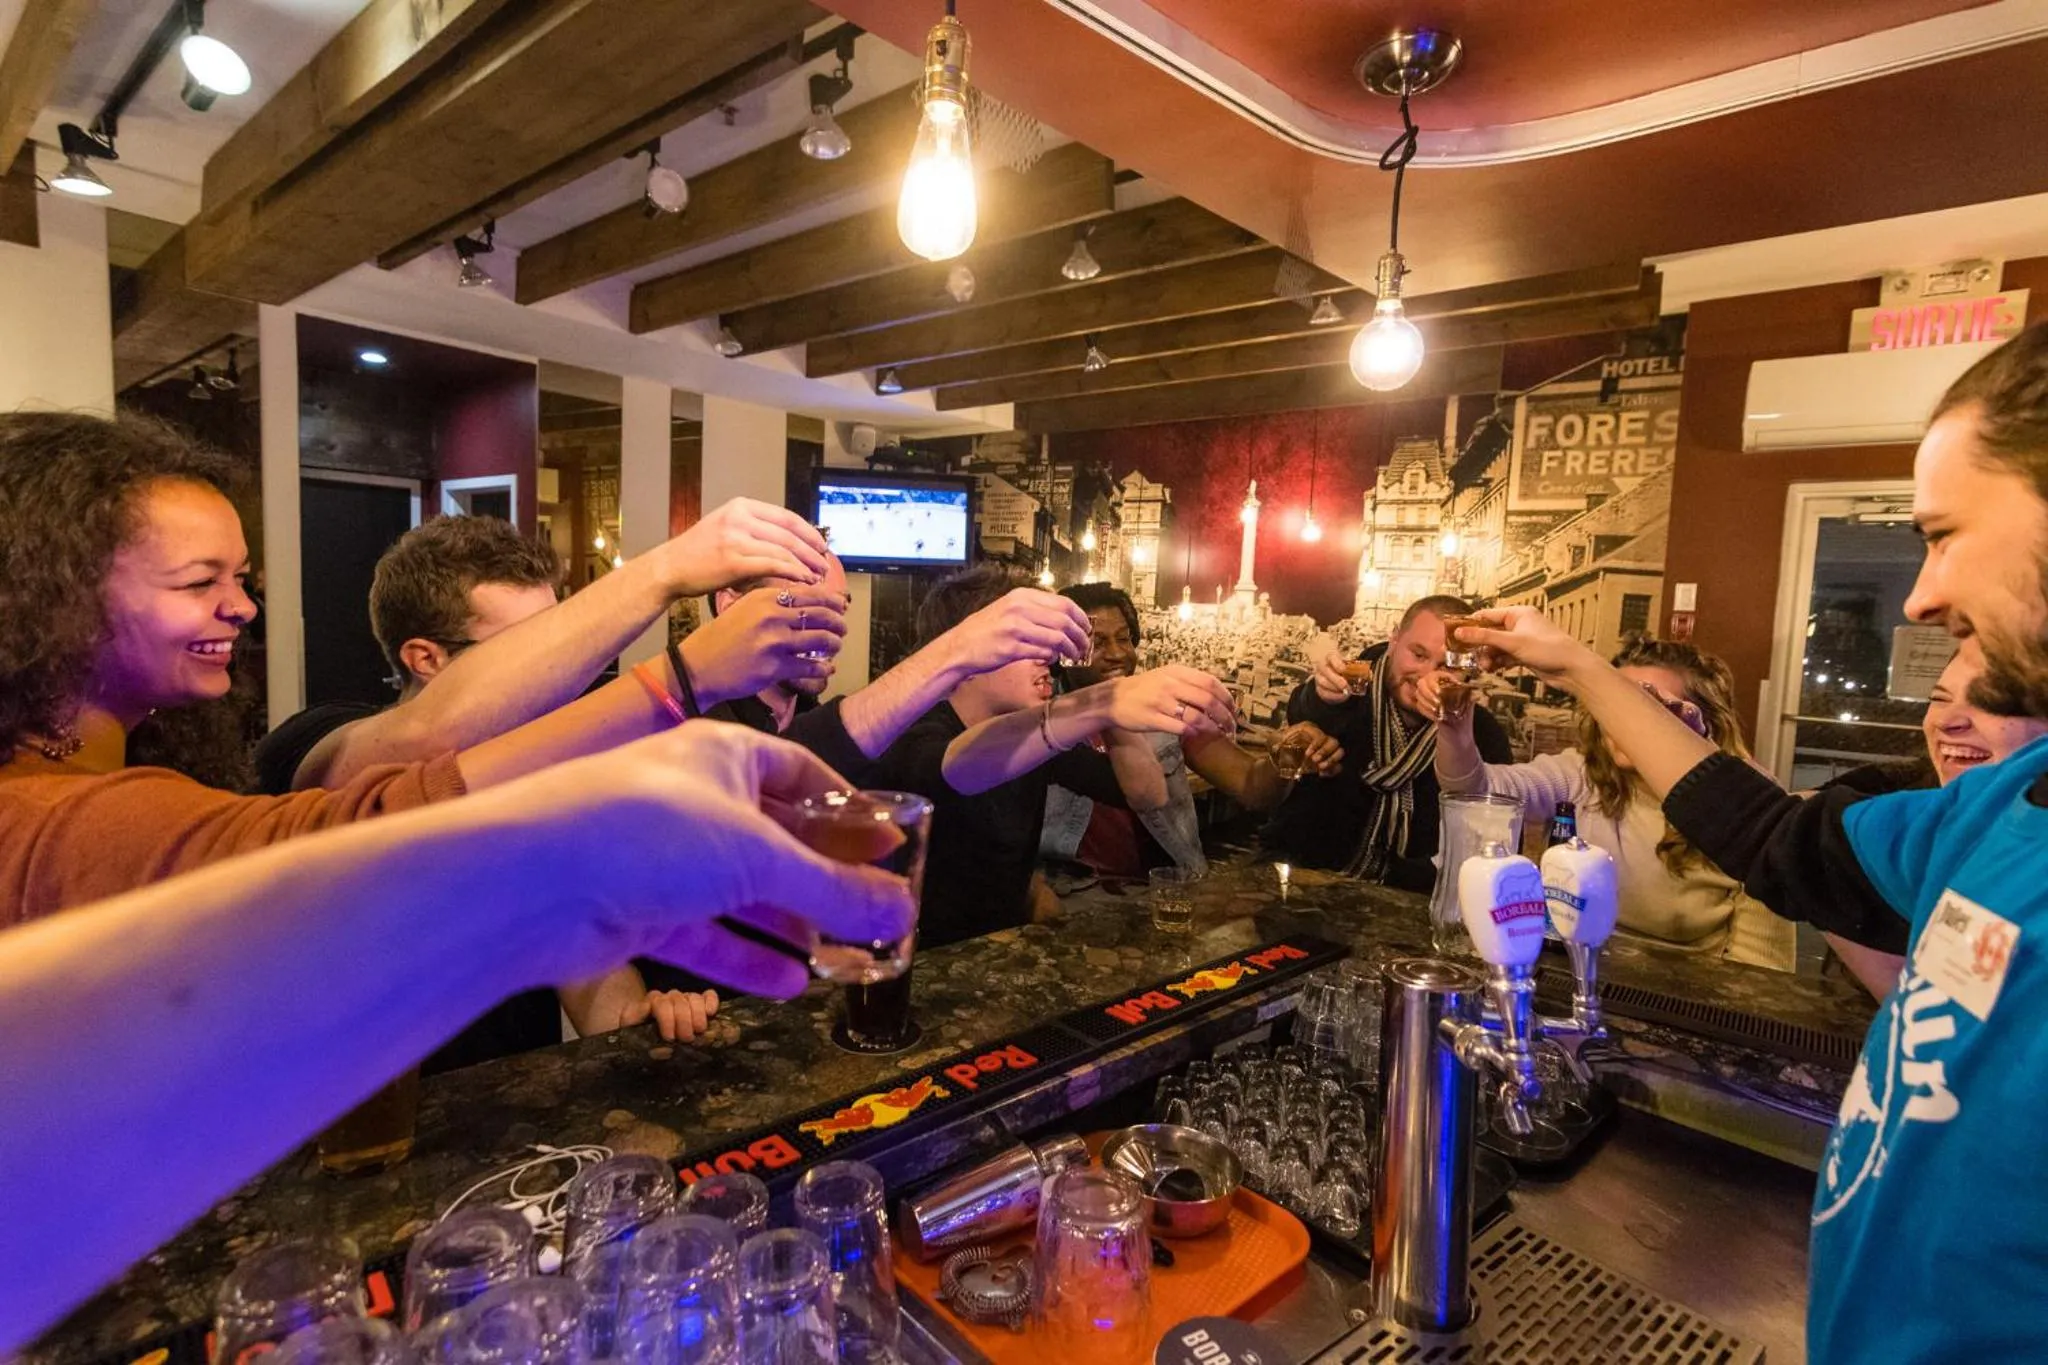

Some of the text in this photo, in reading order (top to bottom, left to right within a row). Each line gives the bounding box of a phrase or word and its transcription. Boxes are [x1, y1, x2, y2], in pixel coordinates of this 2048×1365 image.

[1871, 297, 2008, 352] SORTIE
[1602, 356, 1675, 378] HOTEL
[1526, 409, 1679, 449] FORES
[679, 1044, 1038, 1187] Red Bull
